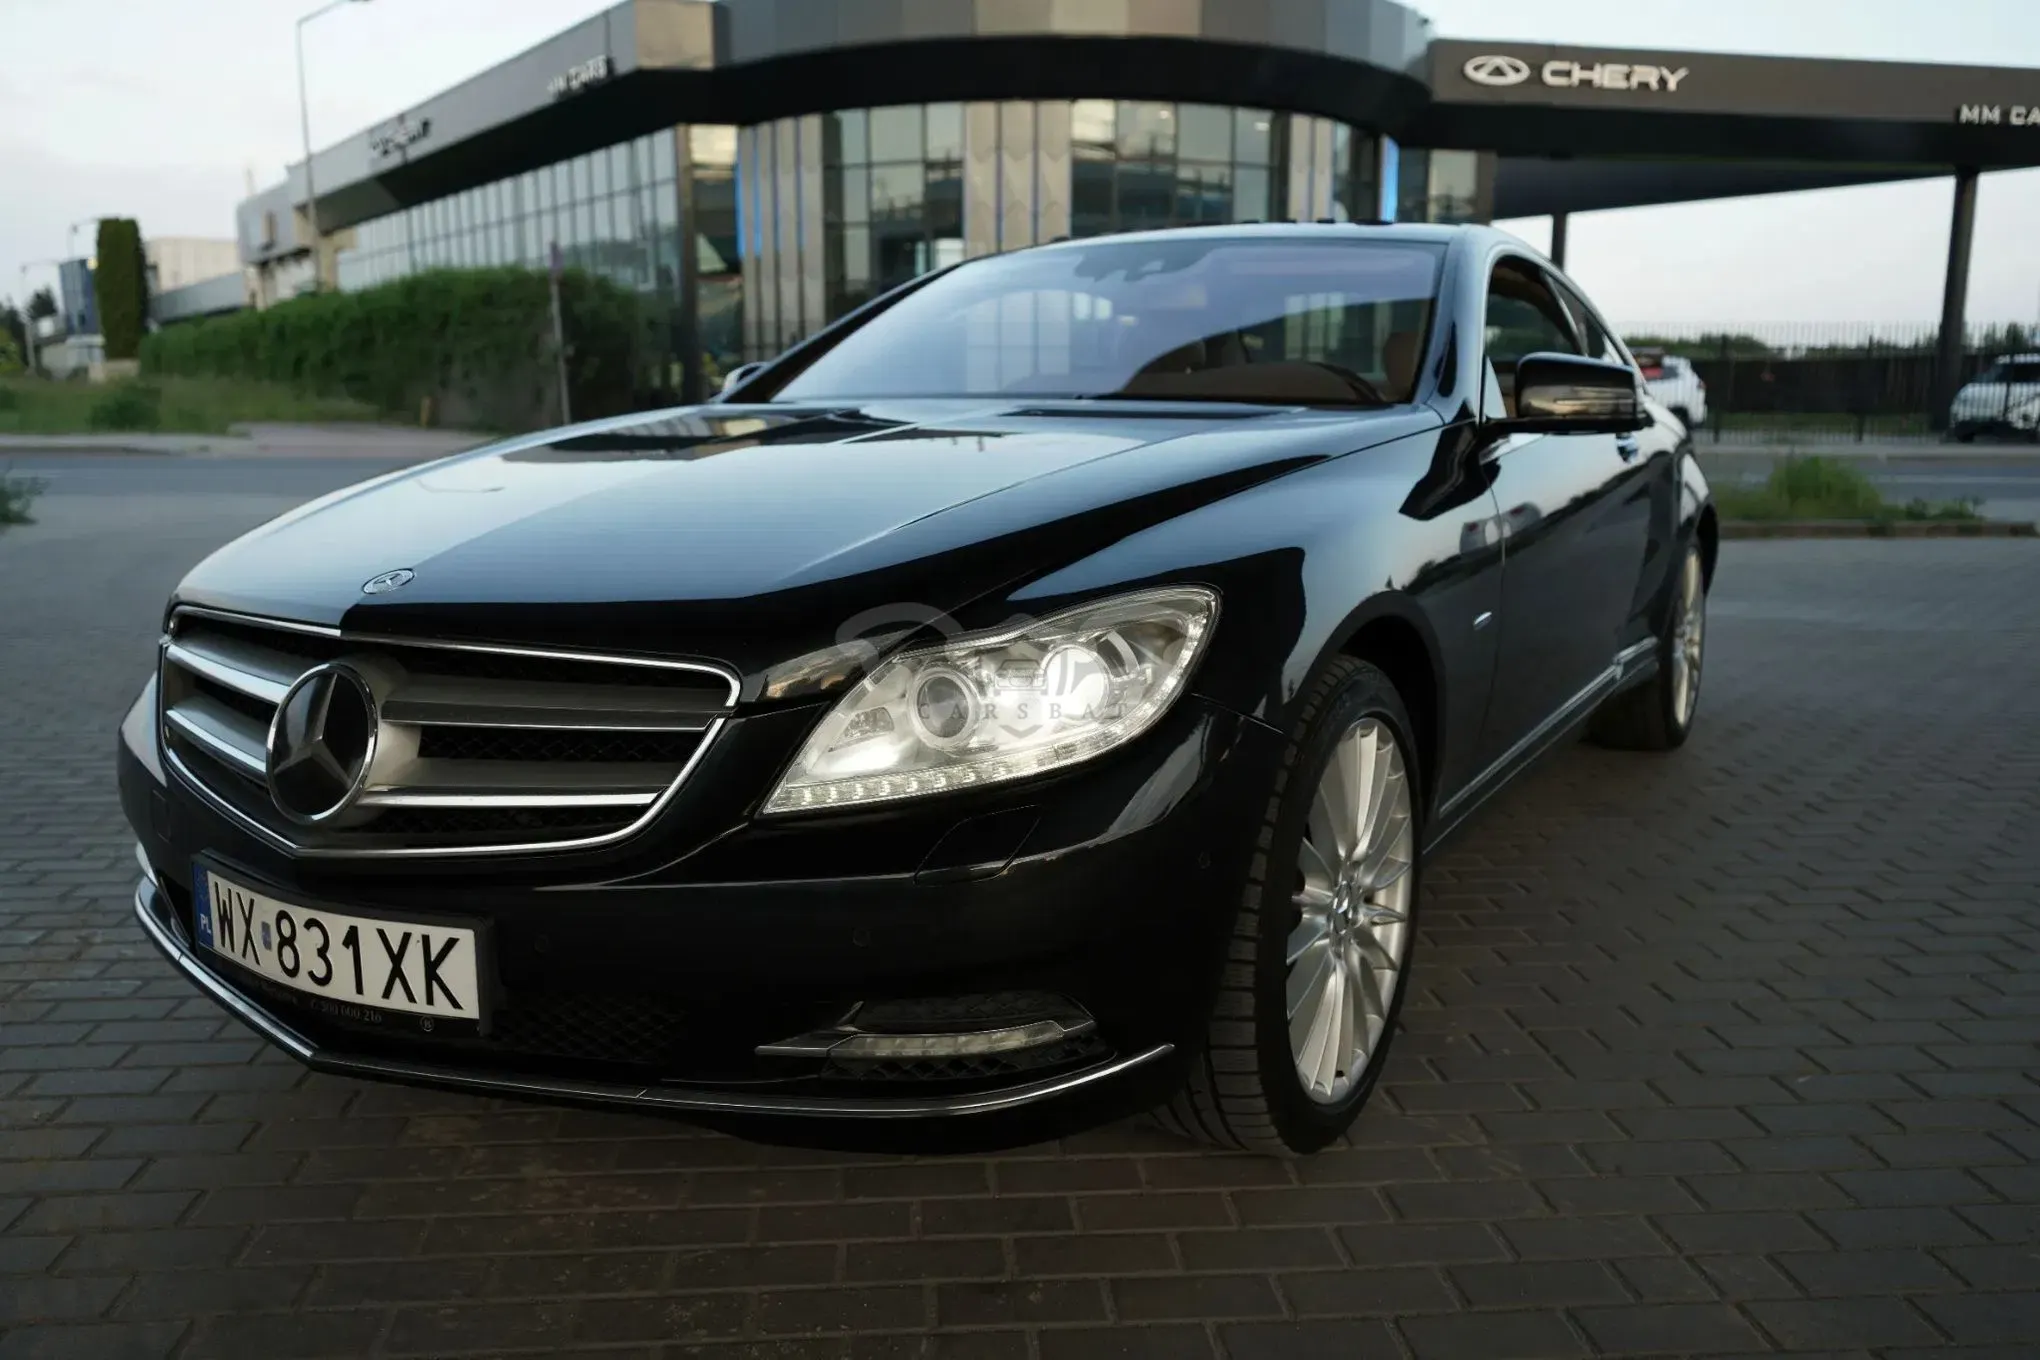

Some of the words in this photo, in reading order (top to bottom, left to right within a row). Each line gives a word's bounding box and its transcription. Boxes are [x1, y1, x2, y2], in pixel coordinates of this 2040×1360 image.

[1542, 60, 1689, 92] CHERY
[1959, 103, 2001, 125] MM
[2009, 104, 2040, 126] CA
[200, 913, 212, 934] PL
[214, 881, 261, 966] WX
[275, 909, 464, 1010] 831XK
